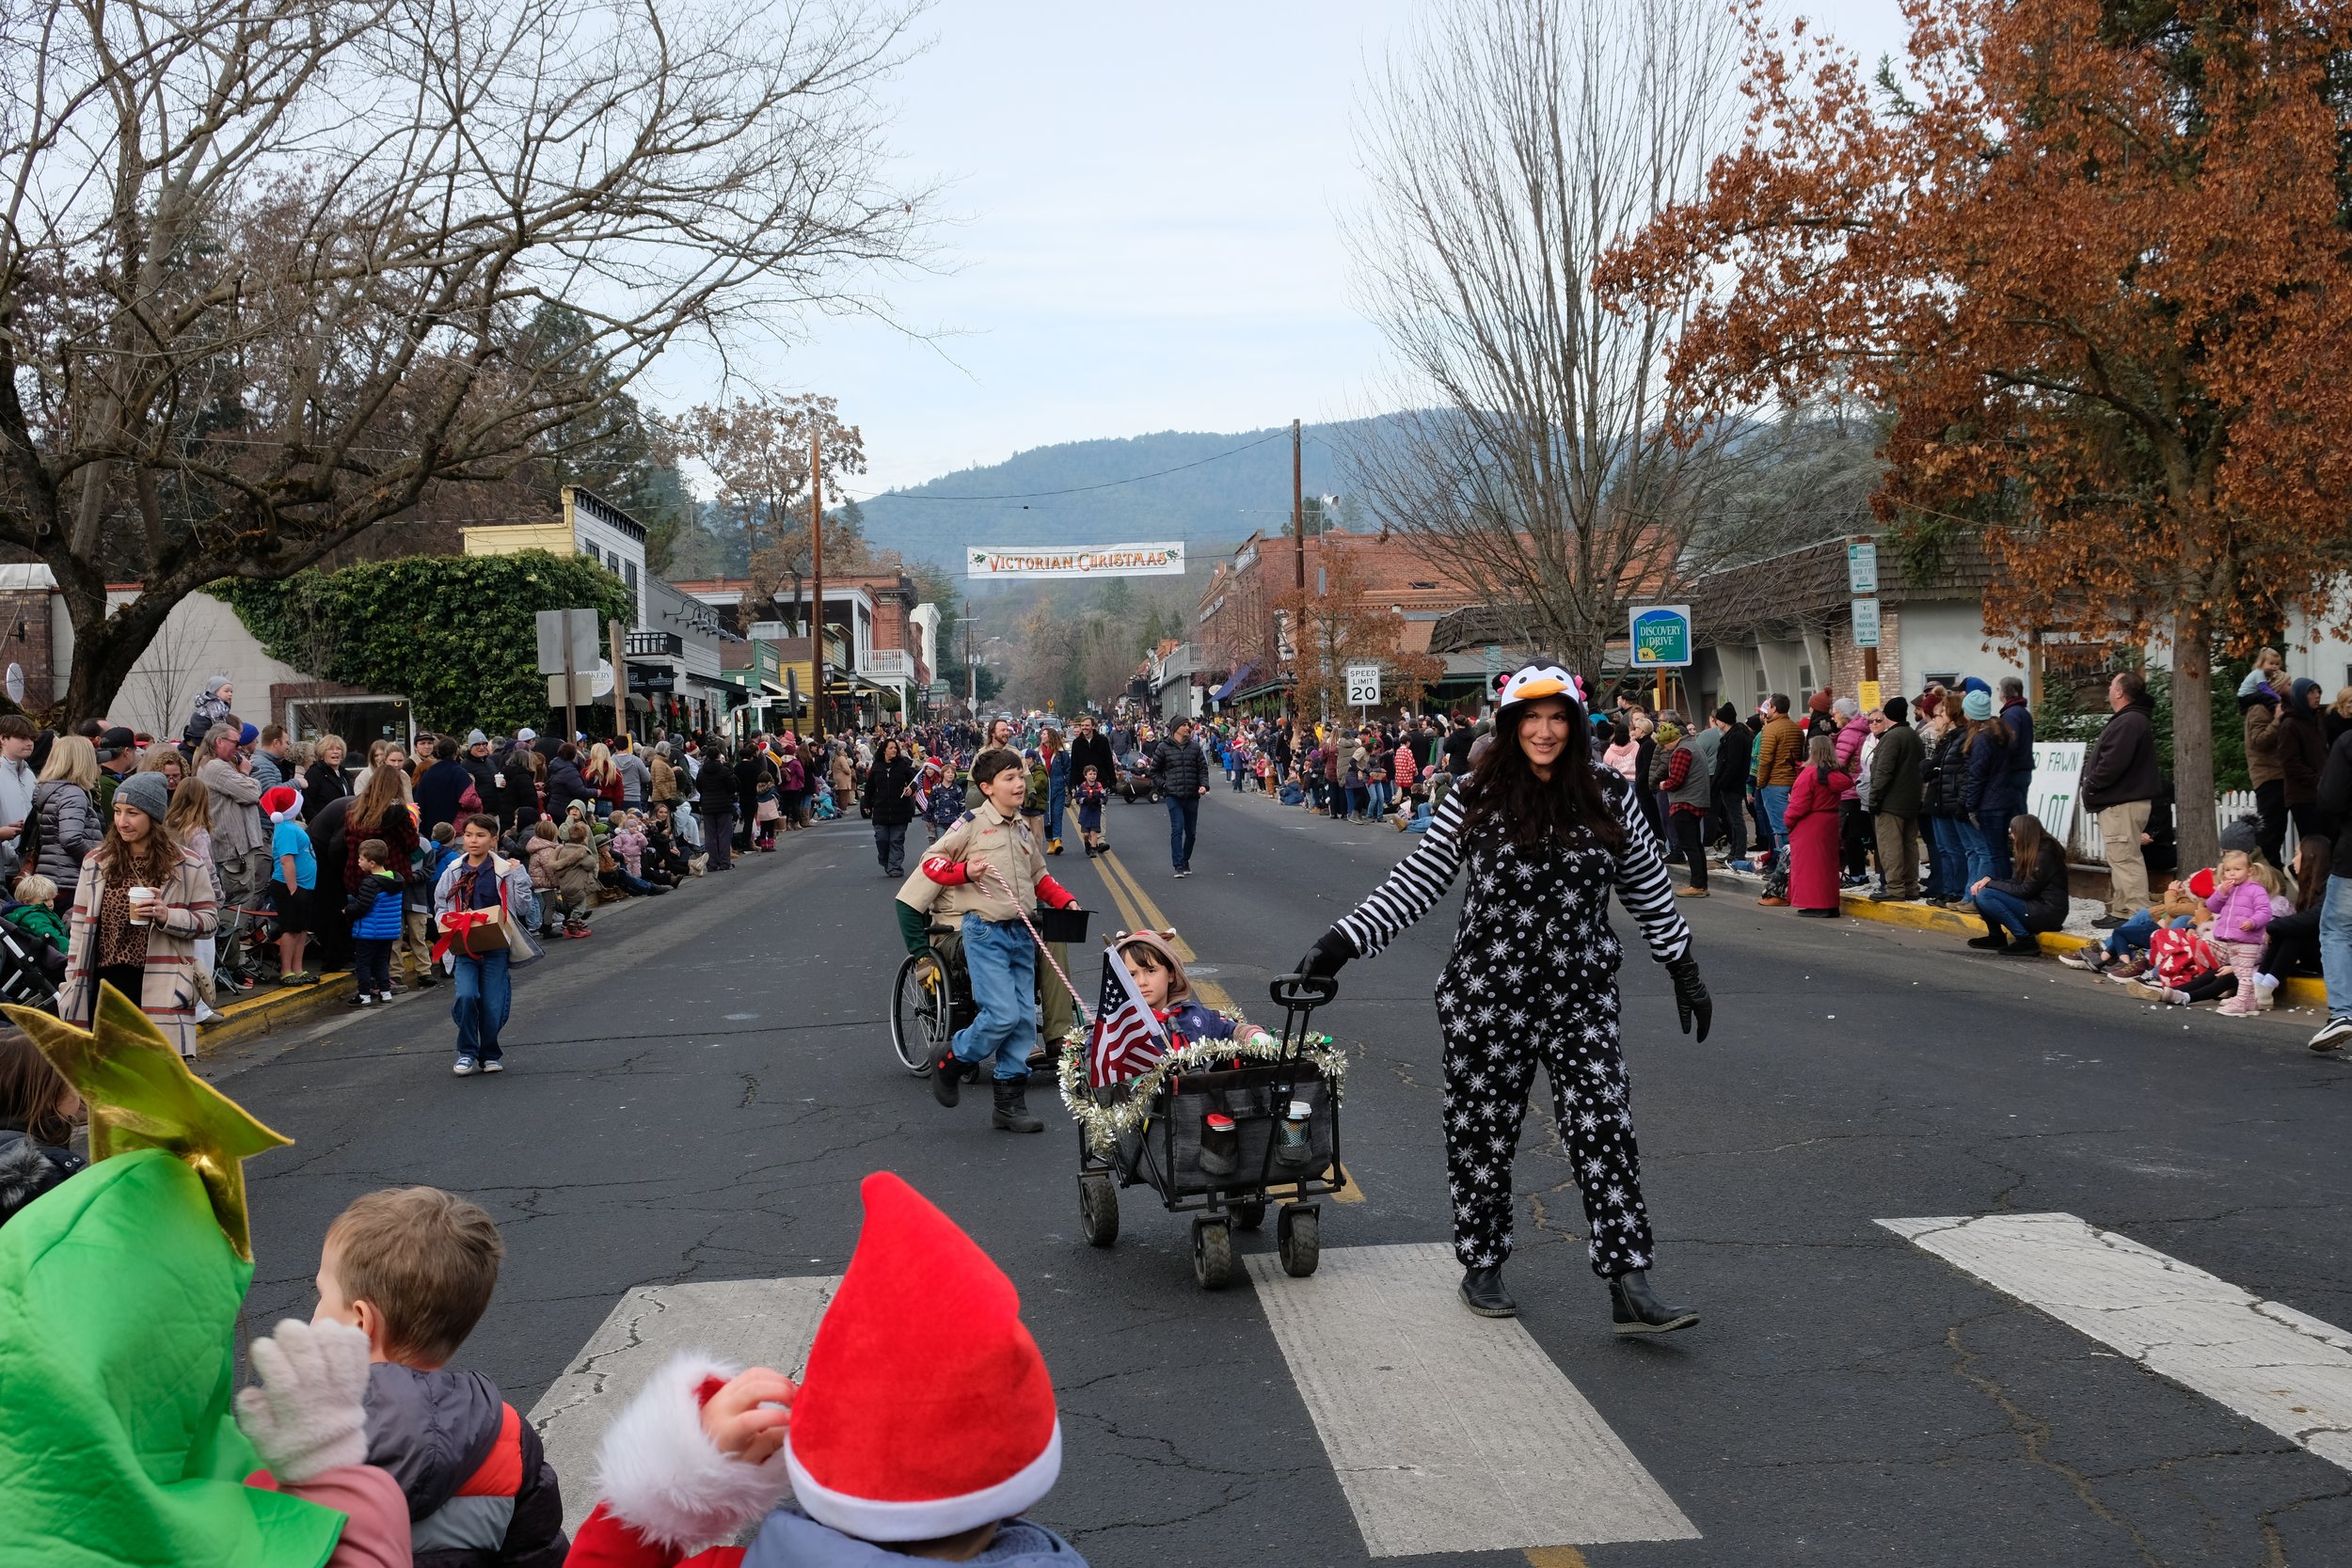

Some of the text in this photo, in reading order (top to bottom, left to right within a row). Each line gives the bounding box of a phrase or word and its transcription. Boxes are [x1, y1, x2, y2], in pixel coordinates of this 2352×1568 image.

[988, 551, 1168, 572] VICTORIAN CHRISTMAS
[1640, 626, 1681, 636] DISCOVERY
[1649, 636, 1674, 646] DRIVE
[1351, 687, 1376, 701] 20
[2047, 752, 2079, 771] FAWN
